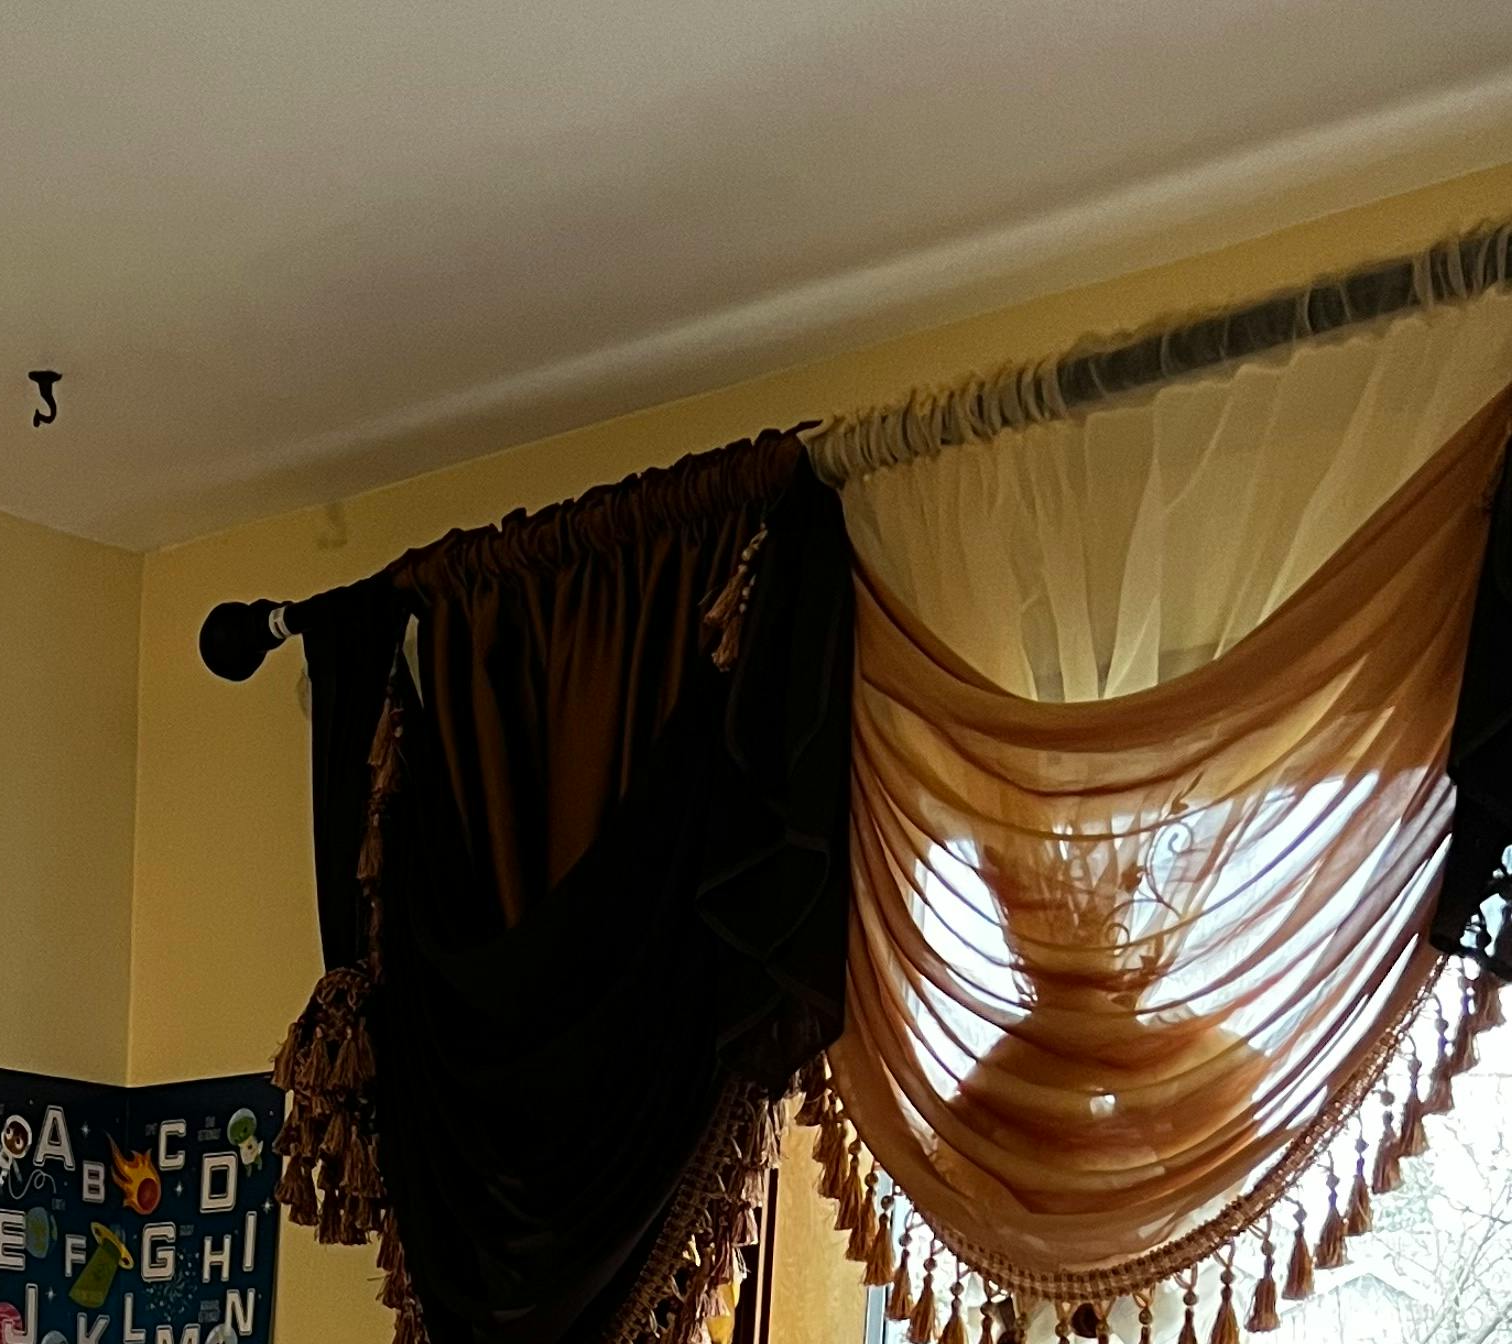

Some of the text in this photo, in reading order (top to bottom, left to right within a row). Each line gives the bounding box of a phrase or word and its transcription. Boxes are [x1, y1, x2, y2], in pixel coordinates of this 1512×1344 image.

[32, 1104, 76, 1171] A
[82, 1160, 106, 1203] B
[159, 1119, 186, 1171] C
[200, 1151, 238, 1214] D
[65, 1234, 87, 1277] F
[141, 1221, 176, 1283] G
[202, 1235, 232, 1283] H
[243, 1211, 257, 1272] I
[123, 1292, 146, 1344] L
[225, 1288, 256, 1336] N
